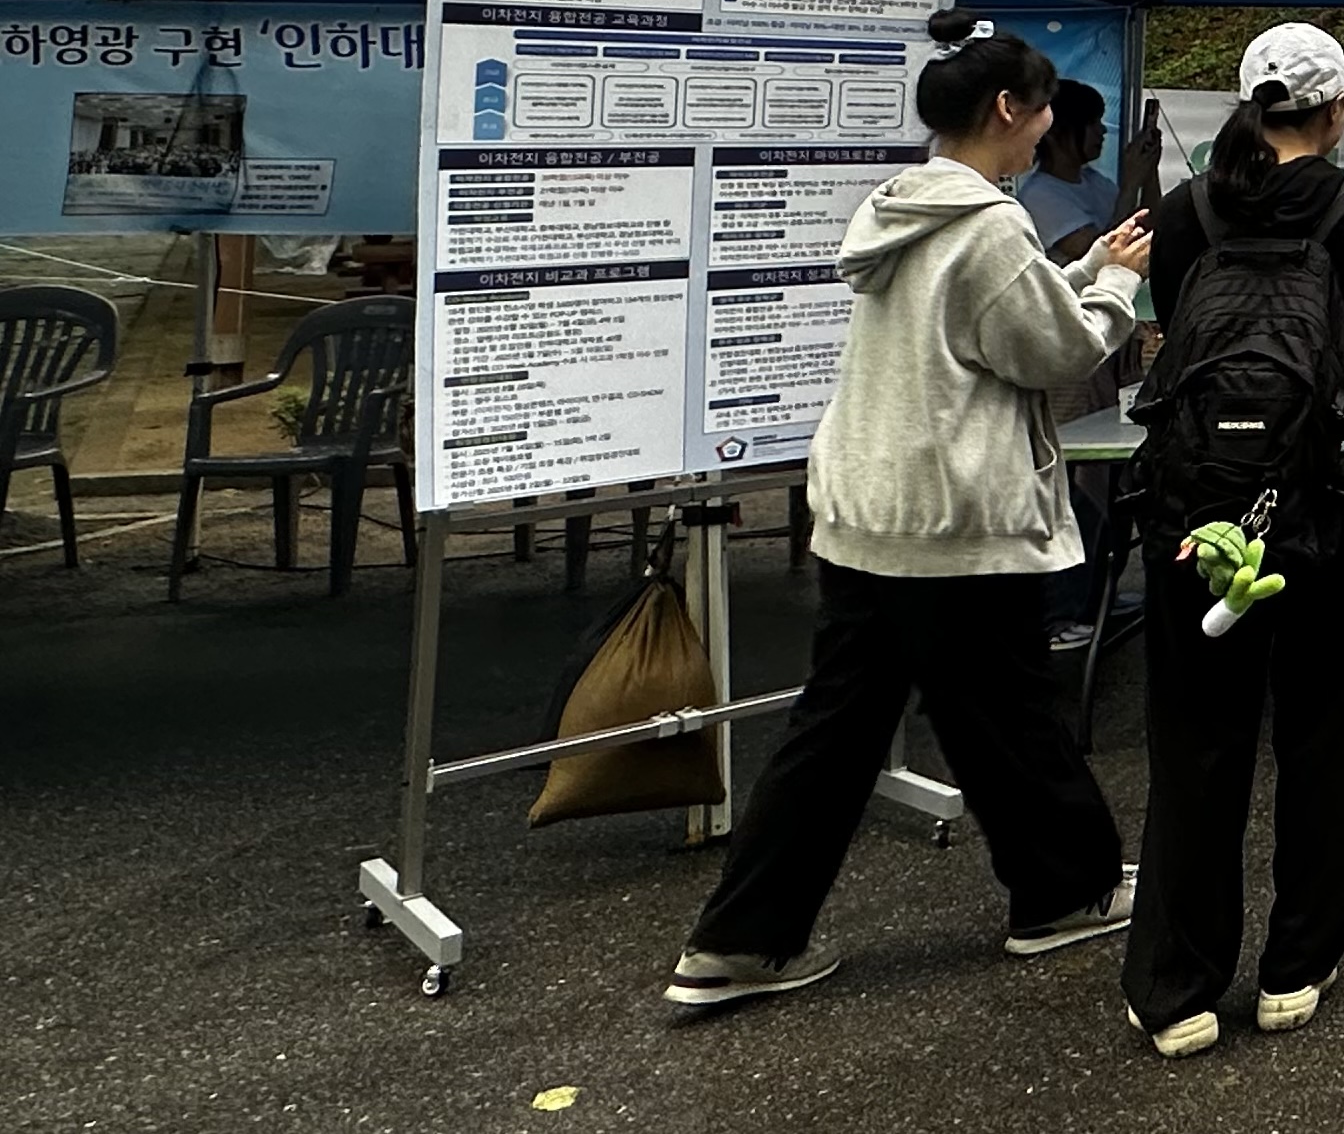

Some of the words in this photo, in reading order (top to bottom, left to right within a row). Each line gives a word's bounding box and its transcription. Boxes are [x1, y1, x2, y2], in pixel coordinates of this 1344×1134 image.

[482, 8, 543, 23] 이차전지
[549, 10, 606, 25] 융합전공
[612, 13, 668, 28] 교육과정
[154, 26, 242, 67] 구현
[478, 152, 539, 166] 이차전지
[544, 151, 603, 165] 융합전공
[618, 151, 660, 164] 부전공
[759, 151, 810, 163] 이차전지
[814, 150, 887, 162] 마이크로전공
[479, 272, 539, 286] 이차전지
[545, 268, 588, 282] 비교과
[593, 265, 650, 279] 프로그램
[752, 270, 803, 283] 이차전지
